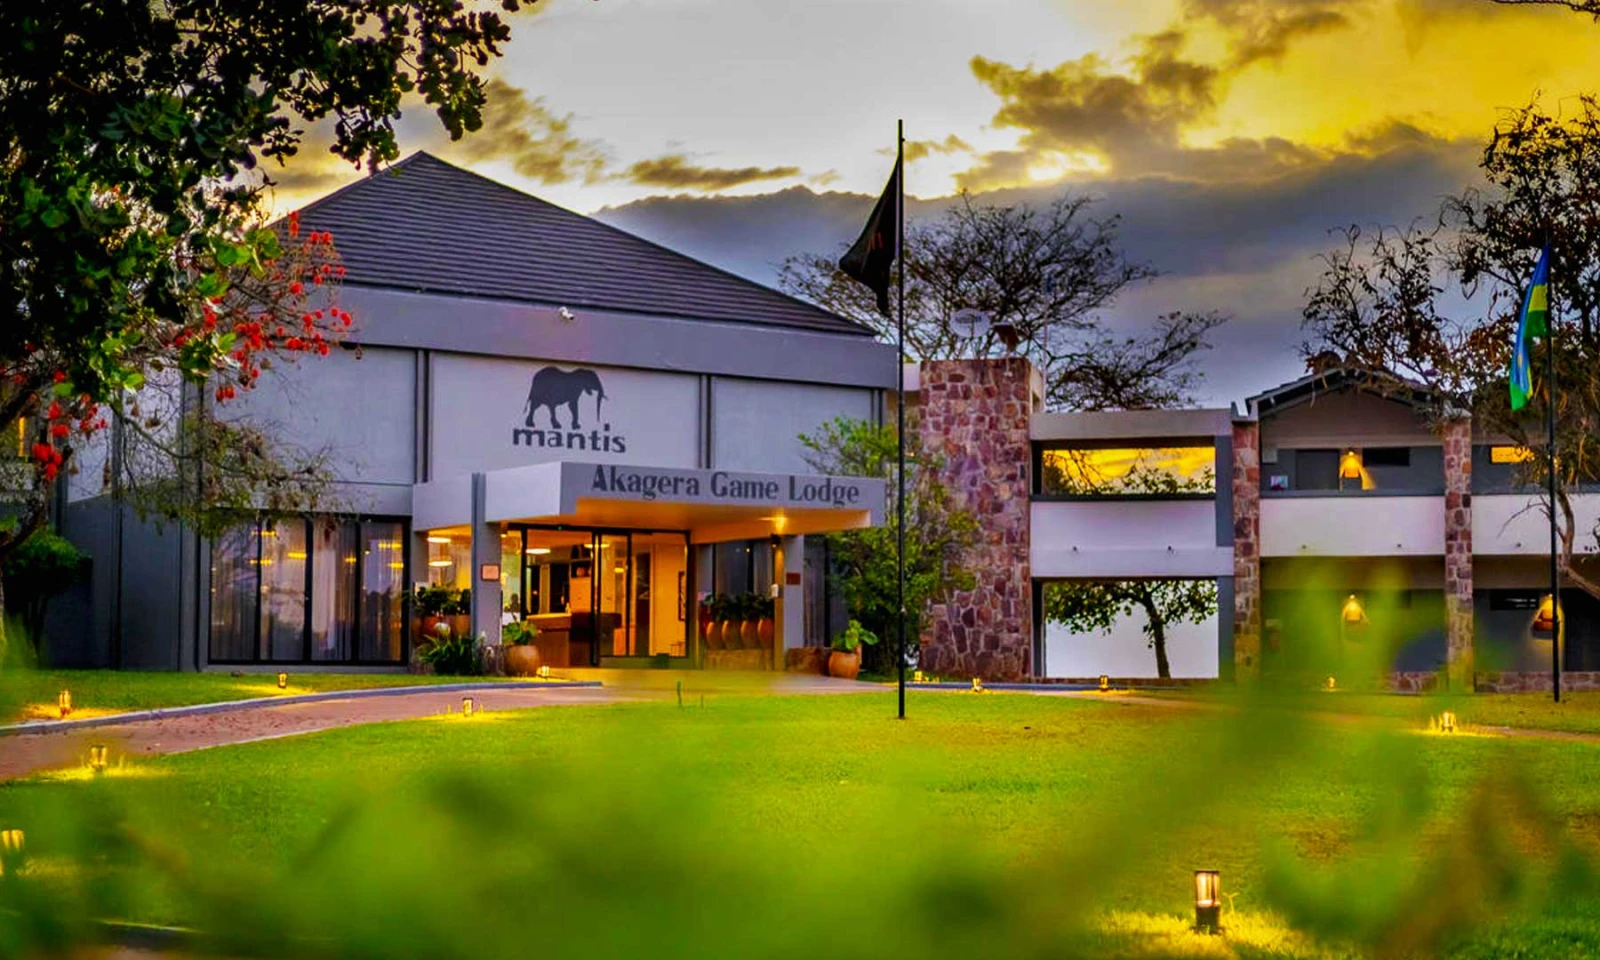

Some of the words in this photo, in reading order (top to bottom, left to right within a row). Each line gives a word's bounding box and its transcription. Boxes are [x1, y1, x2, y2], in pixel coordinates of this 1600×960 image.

[512, 423, 626, 453] mantis
[592, 464, 699, 501] Akagera
[710, 471, 779, 498] Game
[788, 477, 860, 506] Lodge
